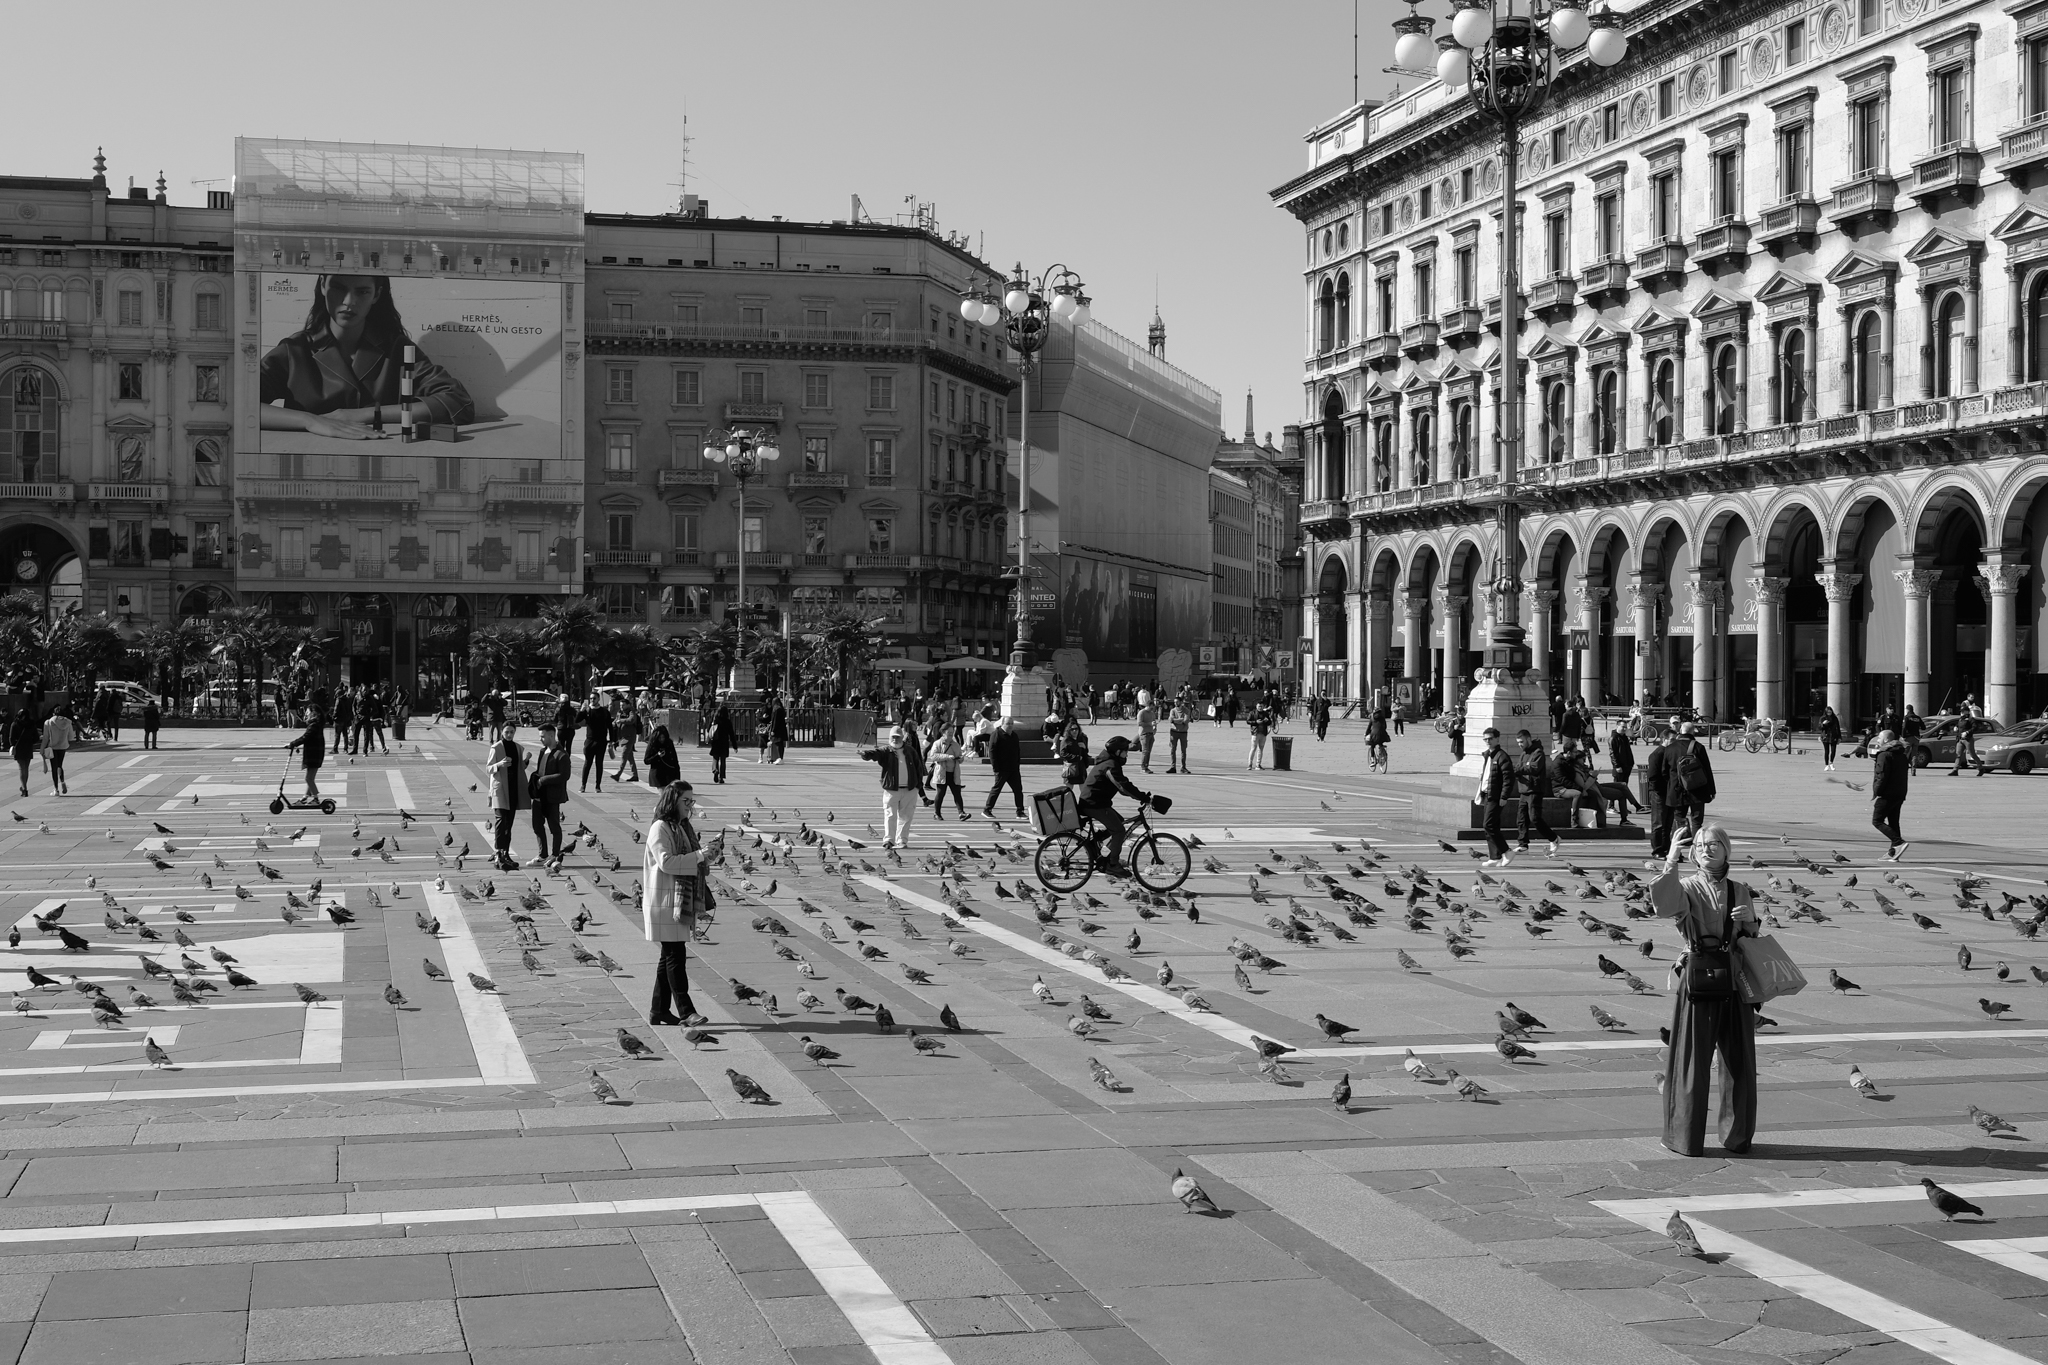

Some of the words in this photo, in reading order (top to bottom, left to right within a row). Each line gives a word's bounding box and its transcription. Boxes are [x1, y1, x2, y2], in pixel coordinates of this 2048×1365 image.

[461, 313, 503, 324] HERMÈS,
[421, 323, 434, 331] LA
[435, 324, 483, 333] BELLEZZA
[485, 323, 491, 333] È
[493, 326, 509, 334] UN
[511, 326, 543, 335] GESTO
[1670, 625, 1694, 634] SARTORIA
[1731, 623, 1756, 632] SARTORIA
